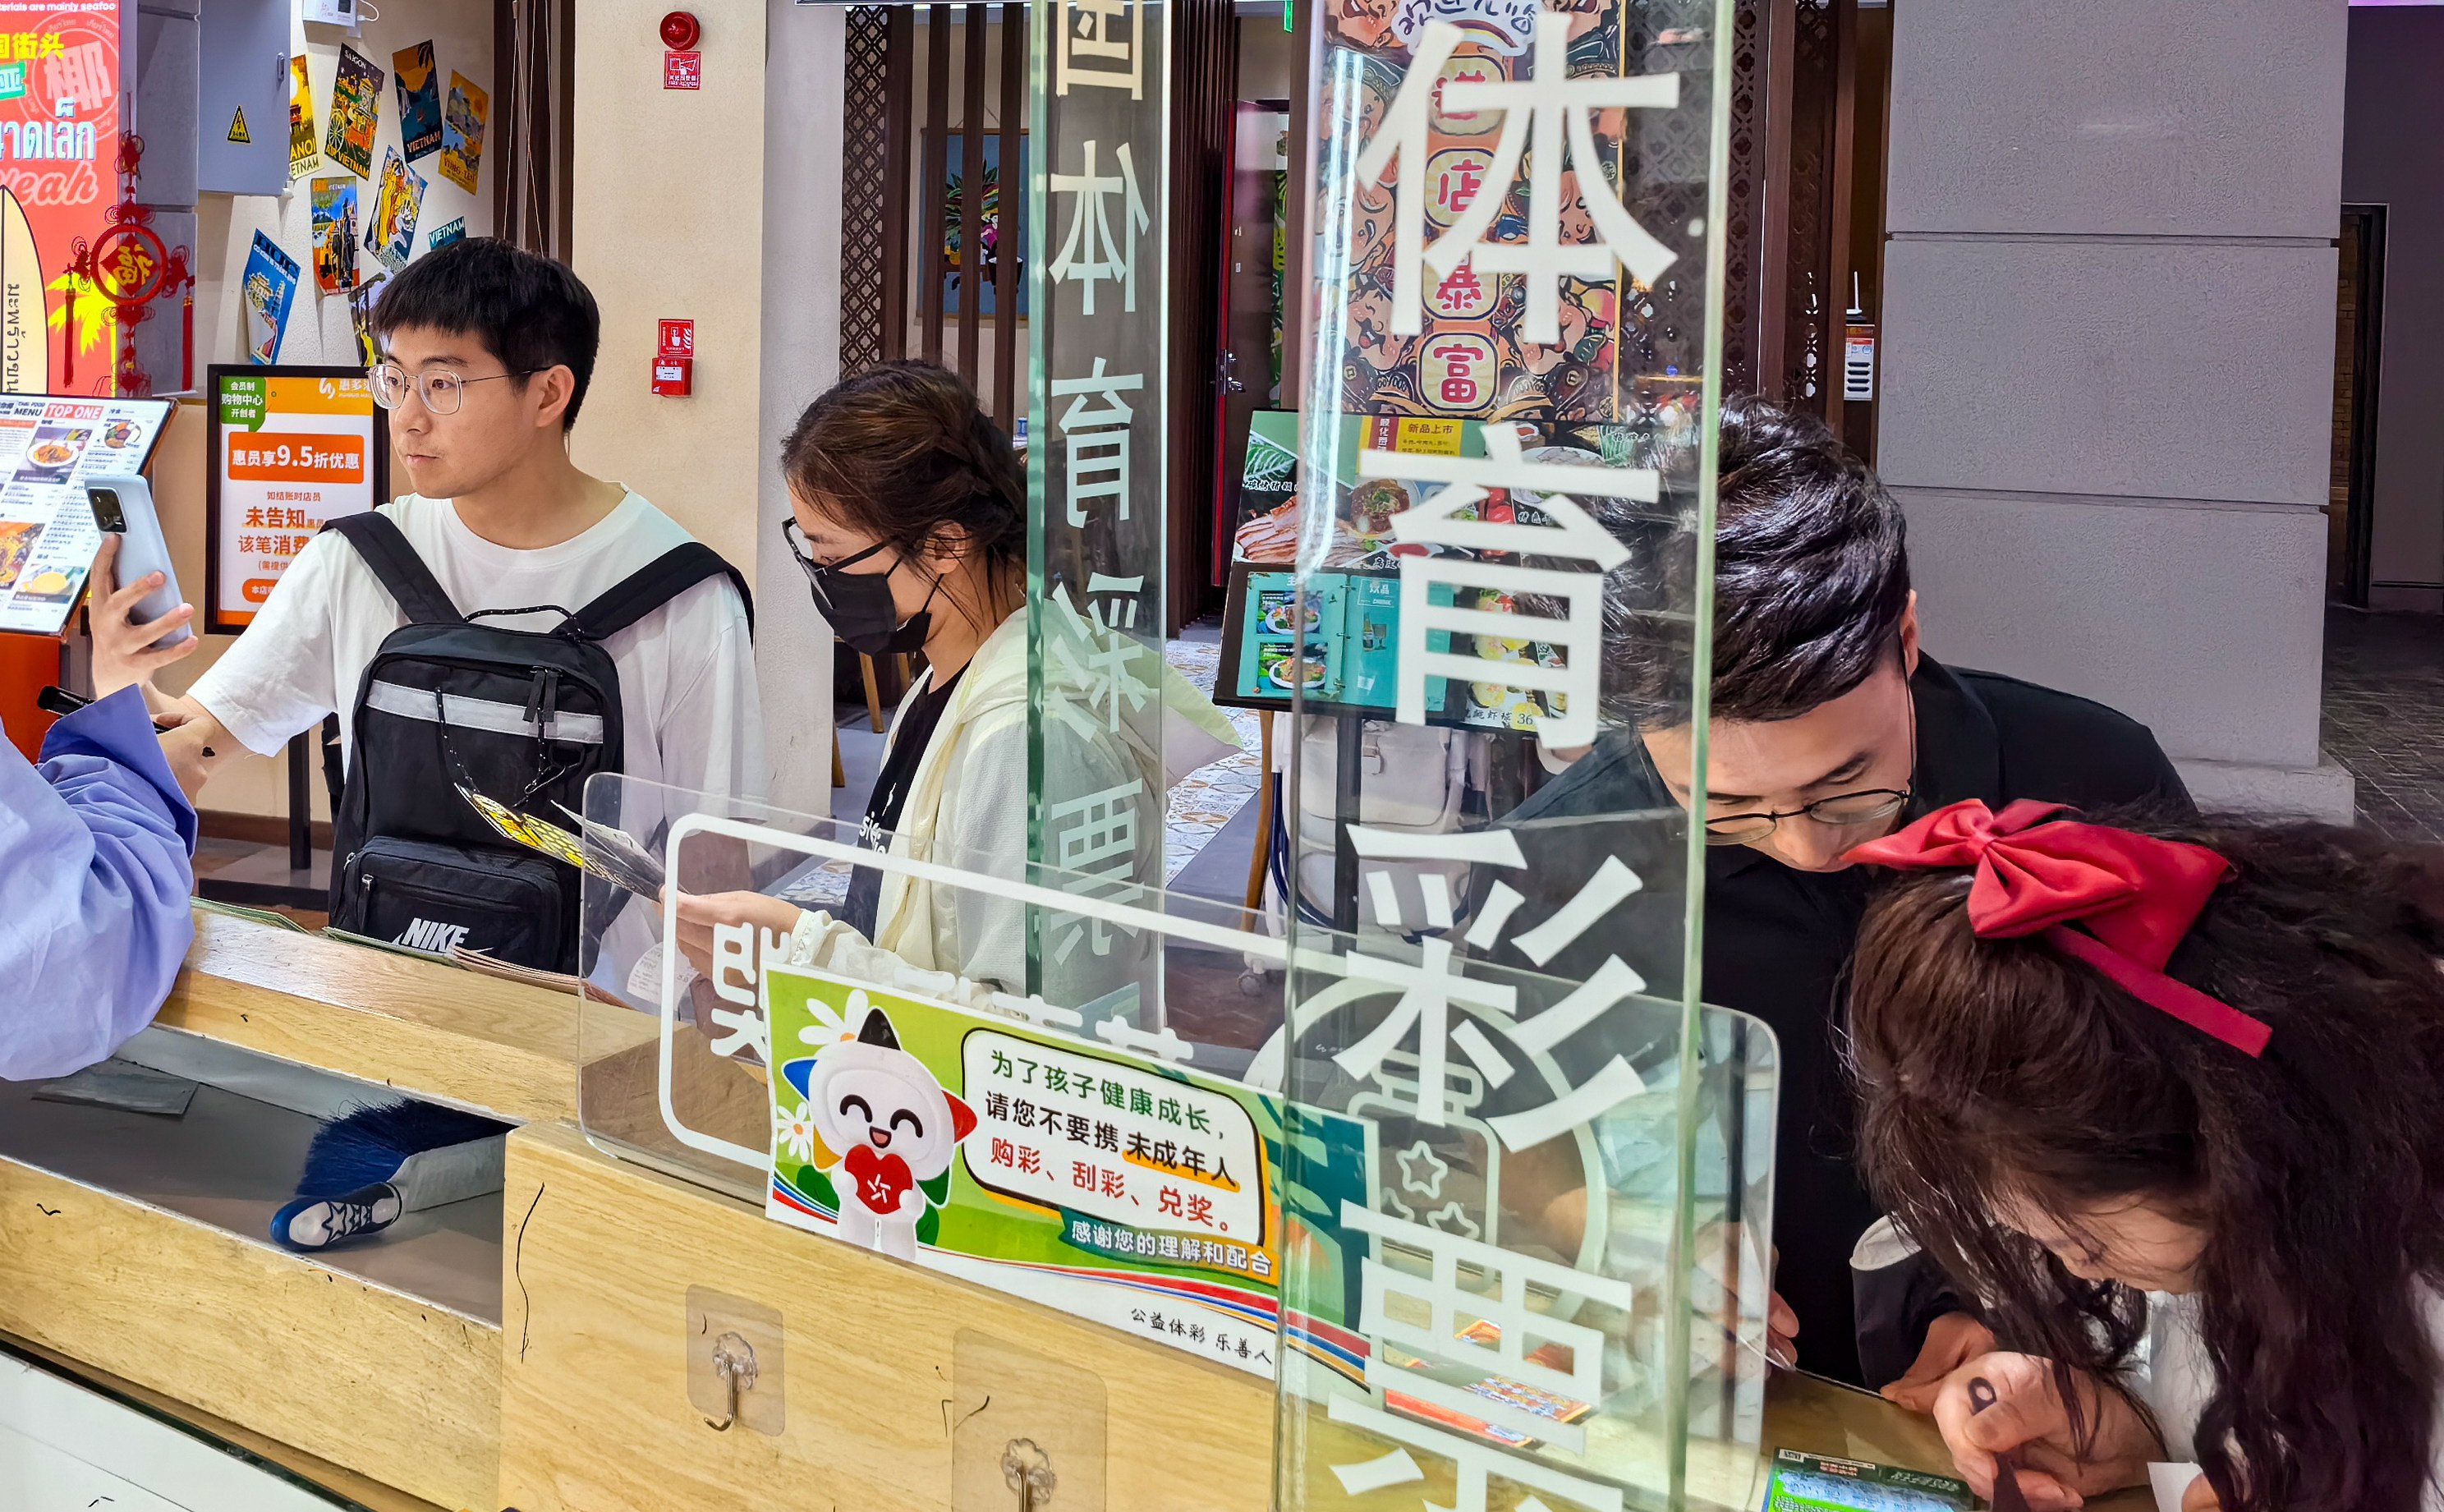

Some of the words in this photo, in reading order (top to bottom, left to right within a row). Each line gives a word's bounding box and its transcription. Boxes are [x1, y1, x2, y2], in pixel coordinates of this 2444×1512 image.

[47, 3, 79, 12] mainly
[0, 96, 96, 160] าดเล็ก
[407, 130, 441, 154] VIETNAM
[338, 151, 370, 182] VIETNAM
[428, 217, 465, 245] VIETNAM
[230, 381, 255, 391] 会员制
[14, 407, 43, 416] MENU
[48, 404, 73, 418] TOP
[73, 407, 102, 420] ONE
[221, 393, 263, 407] 购物中心
[231, 408, 256, 419] 开创者
[1408, 423, 1454, 434] 新品上市
[232, 444, 361, 470] 惠员享9.5折优惠
[267, 491, 321, 502] 如结账时店员
[402, 917, 470, 954] NIKE
[991, 1050, 1224, 1140] 为了孩子健康成长，
[990, 1137, 1229, 1233] 购彩、刮彩、兑奖。
[1071, 1220, 1272, 1276] 感谢您的理解和配合
